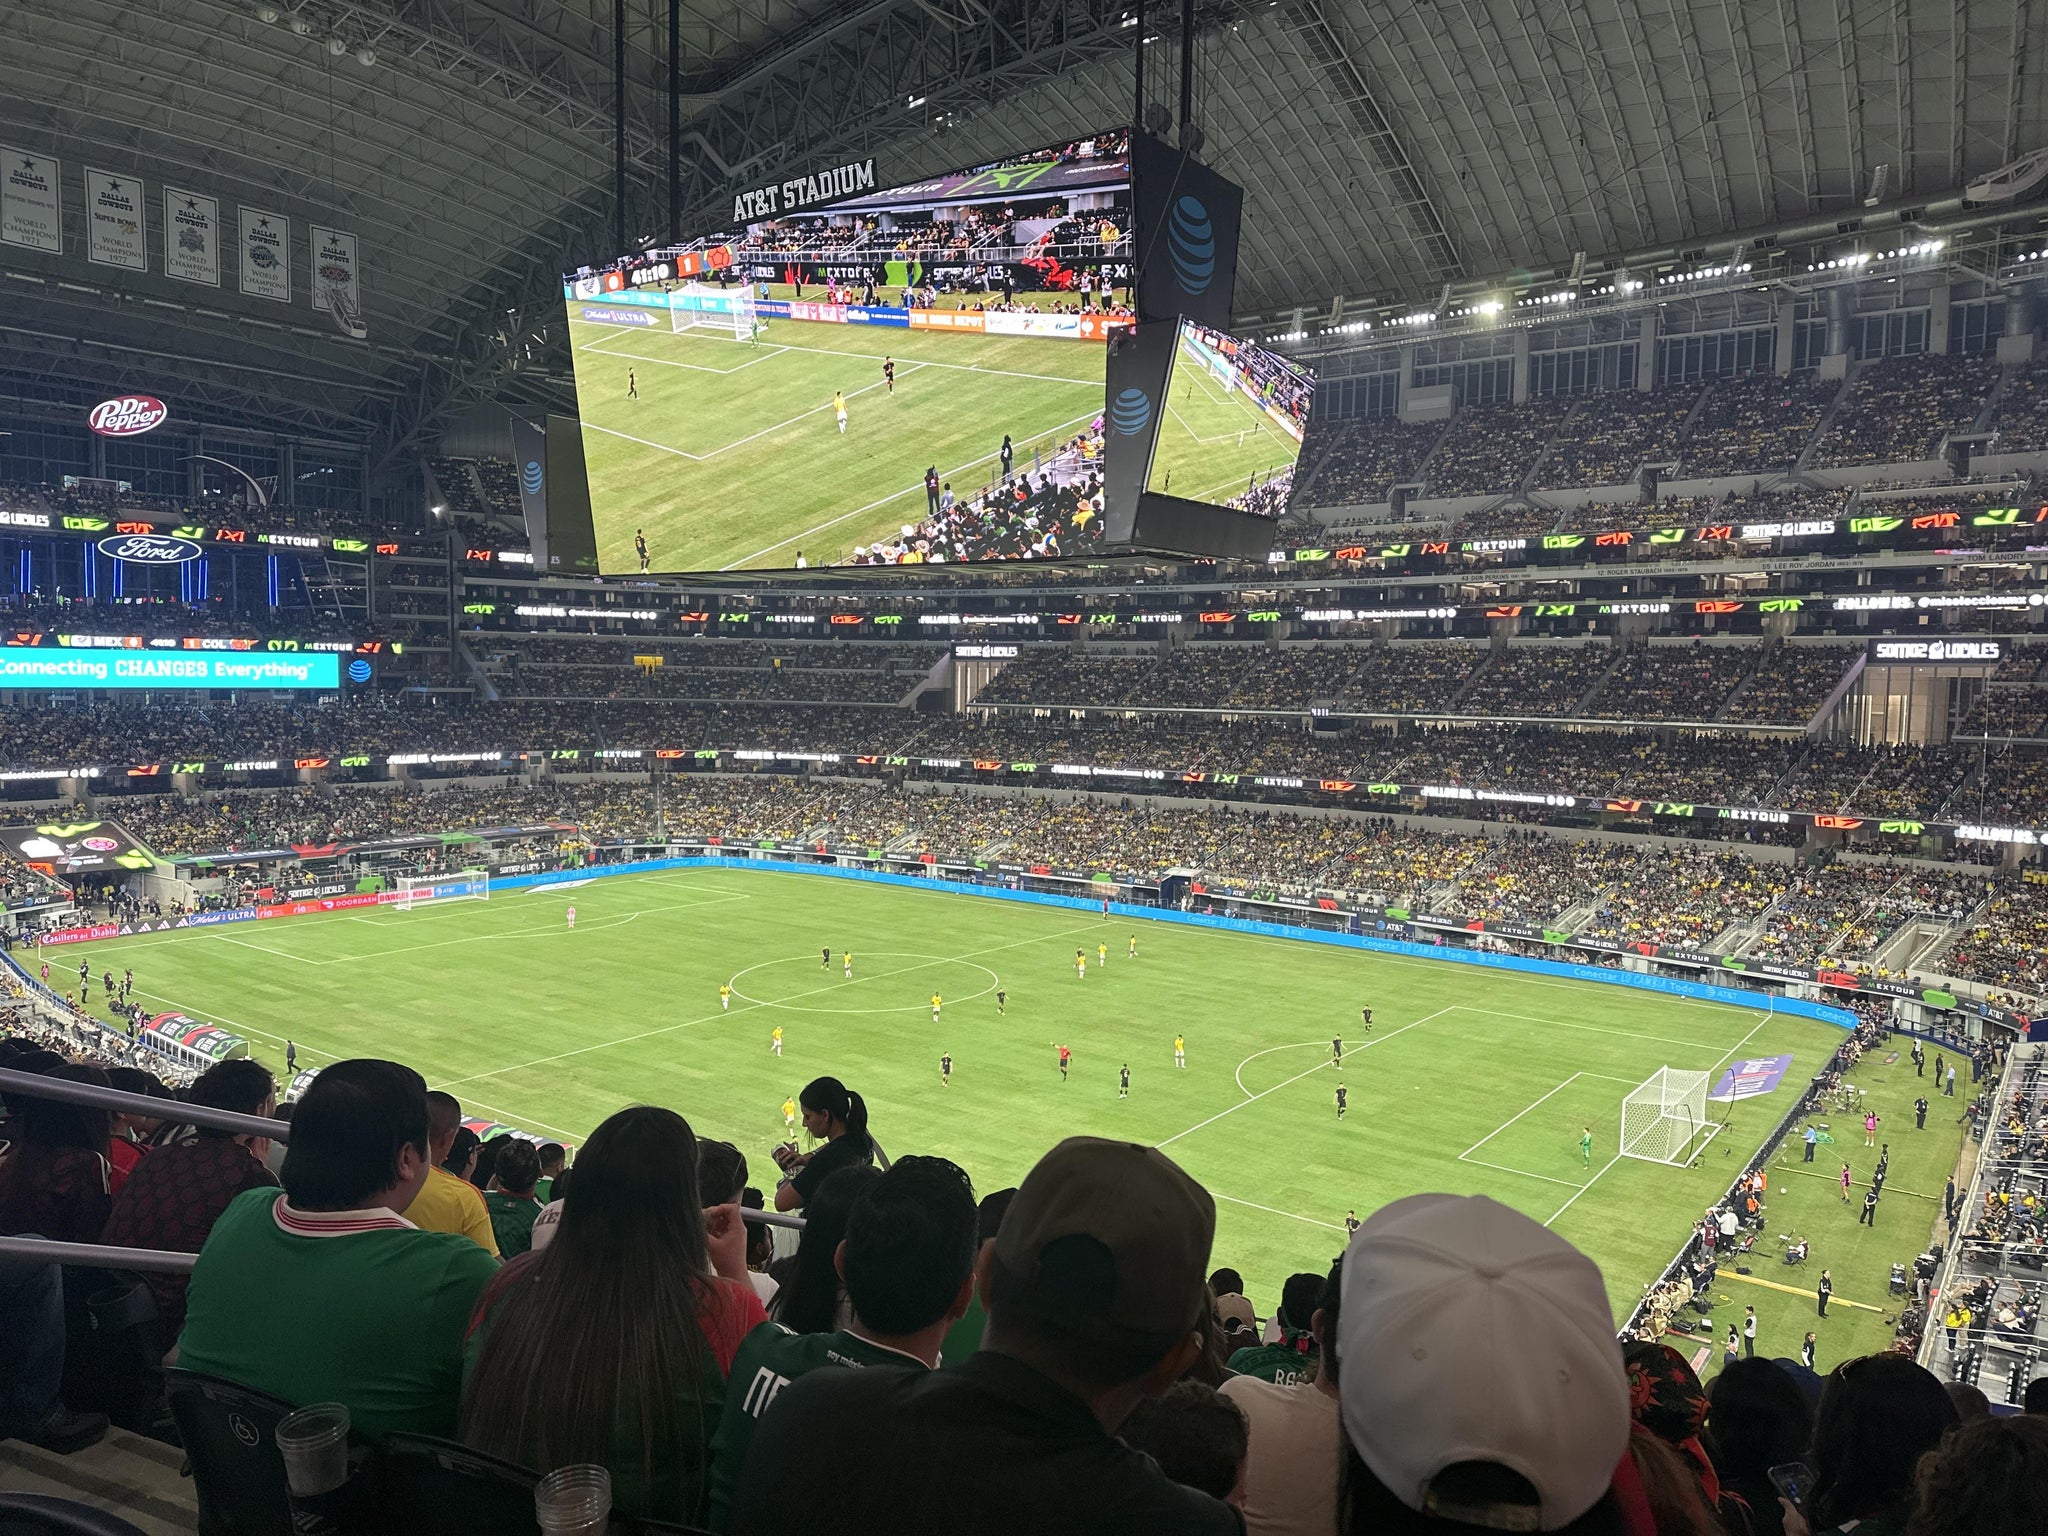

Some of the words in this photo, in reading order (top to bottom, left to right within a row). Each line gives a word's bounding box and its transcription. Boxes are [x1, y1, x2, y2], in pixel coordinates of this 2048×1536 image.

[13, 170, 44, 183] DALLAS
[10, 177, 48, 191] COWBOYS
[734, 185, 779, 222] AT&T
[783, 159, 875, 209] STADIUM
[101, 192, 130, 204] DALLAS
[97, 198, 133, 212] COWBOYS
[94, 212, 116, 224] SUPER
[178, 210, 205, 221] DALLAS
[13, 216, 47, 230] WORLD
[175, 216, 208, 229] COWBOYS
[3, 221, 57, 240] CHAMPIONS
[252, 228, 277, 239] DALLAS
[102, 236, 133, 249] WORLD
[249, 234, 280, 246] COWBOYS
[93, 243, 142, 258] CHAMPIONS
[178, 252, 207, 264] WORLD
[169, 258, 215, 274] CHAMPIONS
[684, 257, 691, 272] 1
[251, 269, 279, 280] WORLD
[631, 264, 669, 285] 41:10
[244, 275, 286, 290] CHAMPIONS
[617, 311, 646, 323] ULTRA
[119, 398, 149, 415] Dr
[94, 400, 162, 431] Pepper
[258, 535, 319, 547] MEXTOUR
[1461, 539, 1526, 551] MEXTOUR
[117, 537, 184, 560] Ford
[1989, 553, 2025, 561] LANDRY
[1599, 604, 1670, 614] MEXTOUR
[1837, 597, 1891, 609] FOLLOW
[1132, 614, 1182, 623] MEXTOUR
[202, 639, 226, 649] COL
[304, 643, 353, 651] MEXTOUR
[1945, 643, 1999, 659] LOCALES
[115, 660, 208, 677] CHANGES
[215, 663, 308, 680] Everything
[1254, 778, 1303, 787] MEXTOUR
[1718, 809, 1789, 823] MEXTOUR
[321, 884, 346, 895] LOCALES
[412, 889, 432, 898] KING
[34, 896, 50, 904] AT&T
[336, 896, 378, 907] DOORDASH
[227, 910, 256, 921] ULTRA
[1346, 905, 1378, 914] MEXTOUR
[1187, 915, 1217, 926] Conectar
[1386, 922, 1404, 931] AT&T
[42, 931, 79, 945] Casillero
[80, 932, 89, 940] del
[91, 927, 118, 939] Diablo
[1495, 926, 1533, 936] MEXTOUR
[1362, 939, 1399, 950] Conectar
[1445, 949, 1468, 960] Todo
[1487, 956, 1506, 964] AT&T
[1667, 951, 1710, 962] MEXTOUR
[1574, 967, 1617, 981] Conectar
[1670, 982, 1694, 993] Todo
[1717, 990, 1738, 1000] AT&T
[1867, 982, 1915, 996] MEXTOUR
[1815, 1007, 1854, 1025] Conectar
[1988, 1009, 2004, 1020] AT&T
[826, 1349, 840, 1363] soy
